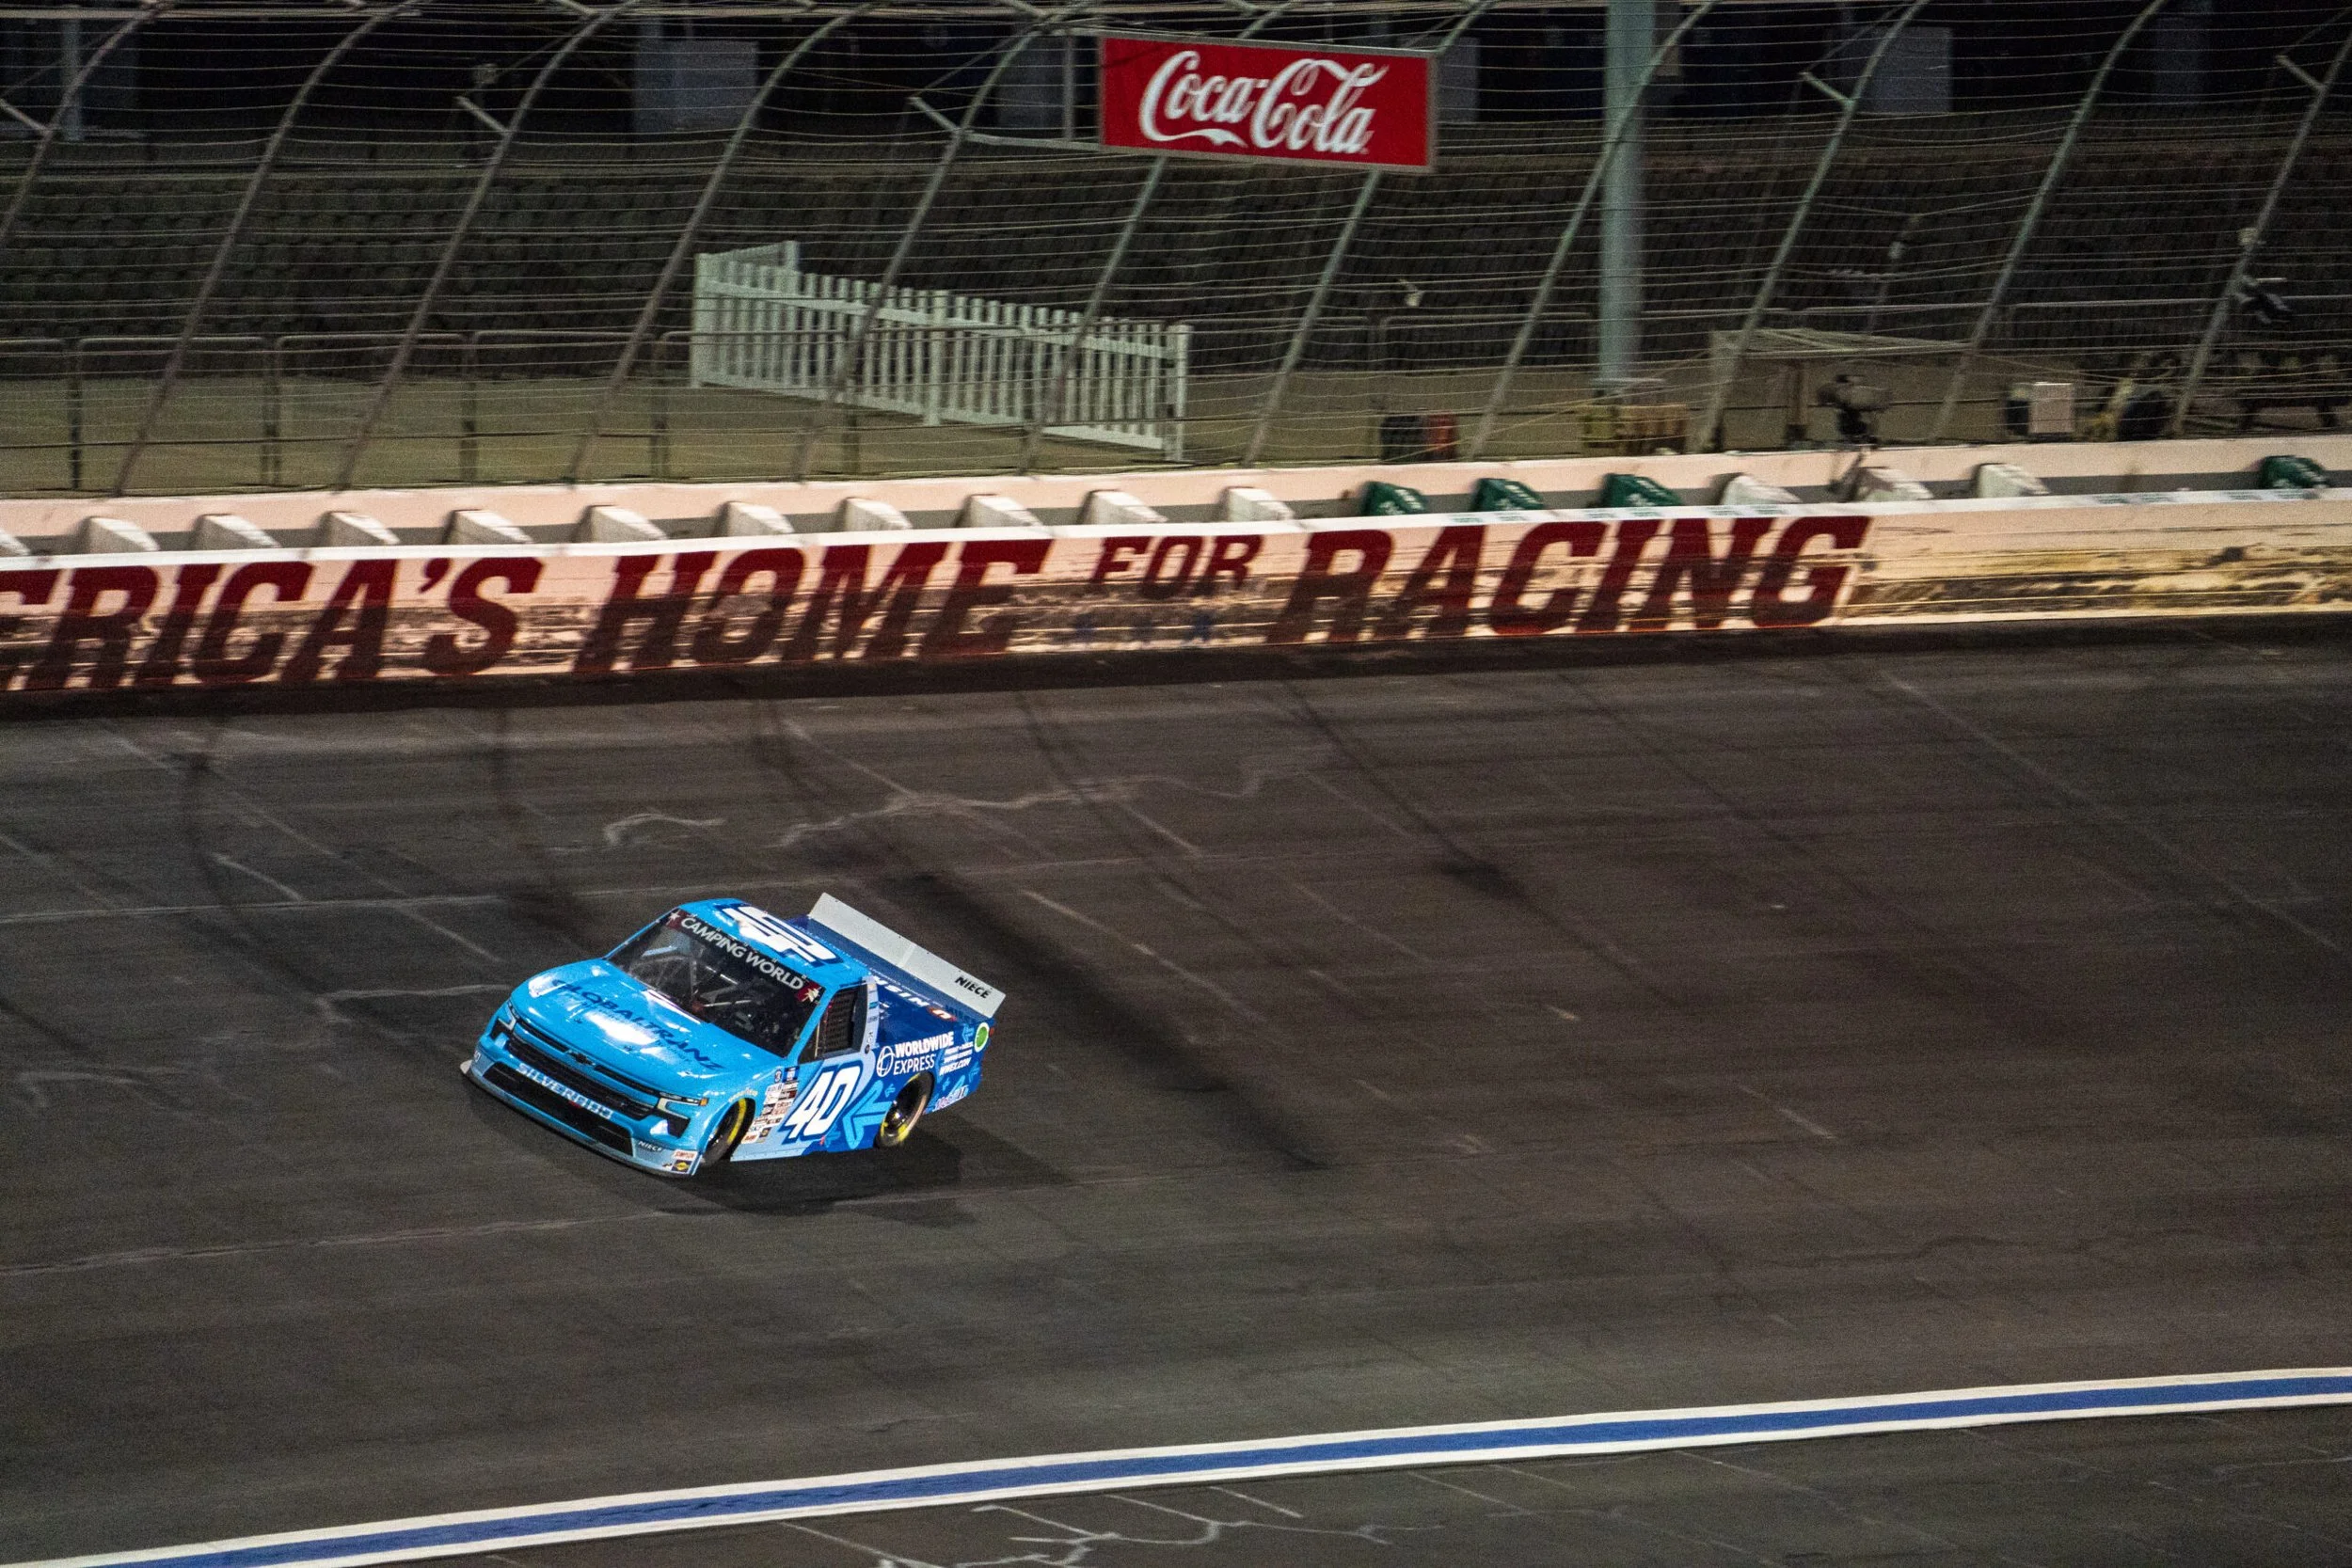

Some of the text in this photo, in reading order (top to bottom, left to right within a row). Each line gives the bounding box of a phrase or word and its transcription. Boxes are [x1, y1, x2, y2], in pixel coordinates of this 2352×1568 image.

[1138, 50, 1390, 155] Coca-Cola
[567, 539, 1053, 673] HOME
[1087, 533, 1263, 599] FOR
[1265, 515, 1873, 645] RACING
[680, 917, 804, 991] CAMPING WORLD
[954, 976, 992, 1000] NIECE
[893, 1054, 936, 1076] EXPRESS
[895, 1031, 955, 1058] WORLDWIDE
[784, 1065, 862, 1140] 40
